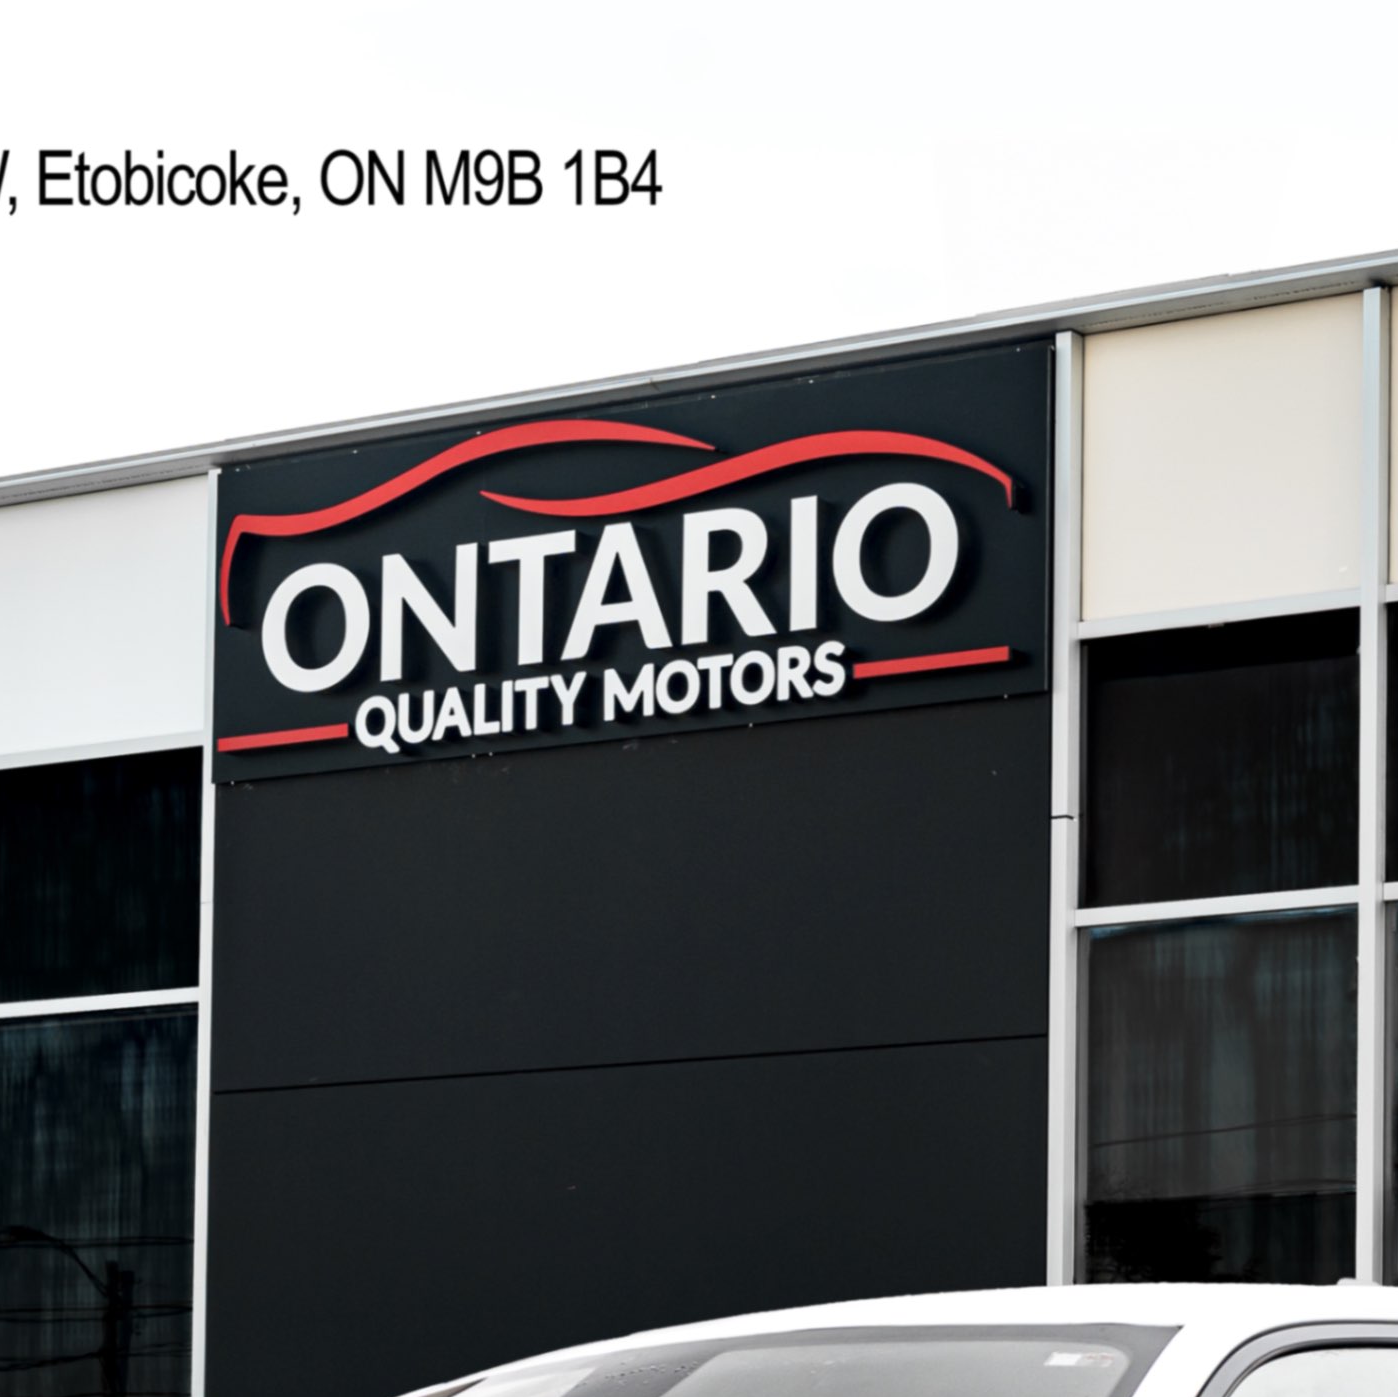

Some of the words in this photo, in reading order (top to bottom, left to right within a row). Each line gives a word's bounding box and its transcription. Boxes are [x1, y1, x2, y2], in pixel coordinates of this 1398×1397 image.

[261, 482, 959, 693] ONTARIO
[354, 671, 586, 754] QUALITY
[604, 640, 847, 721] MOTORS
